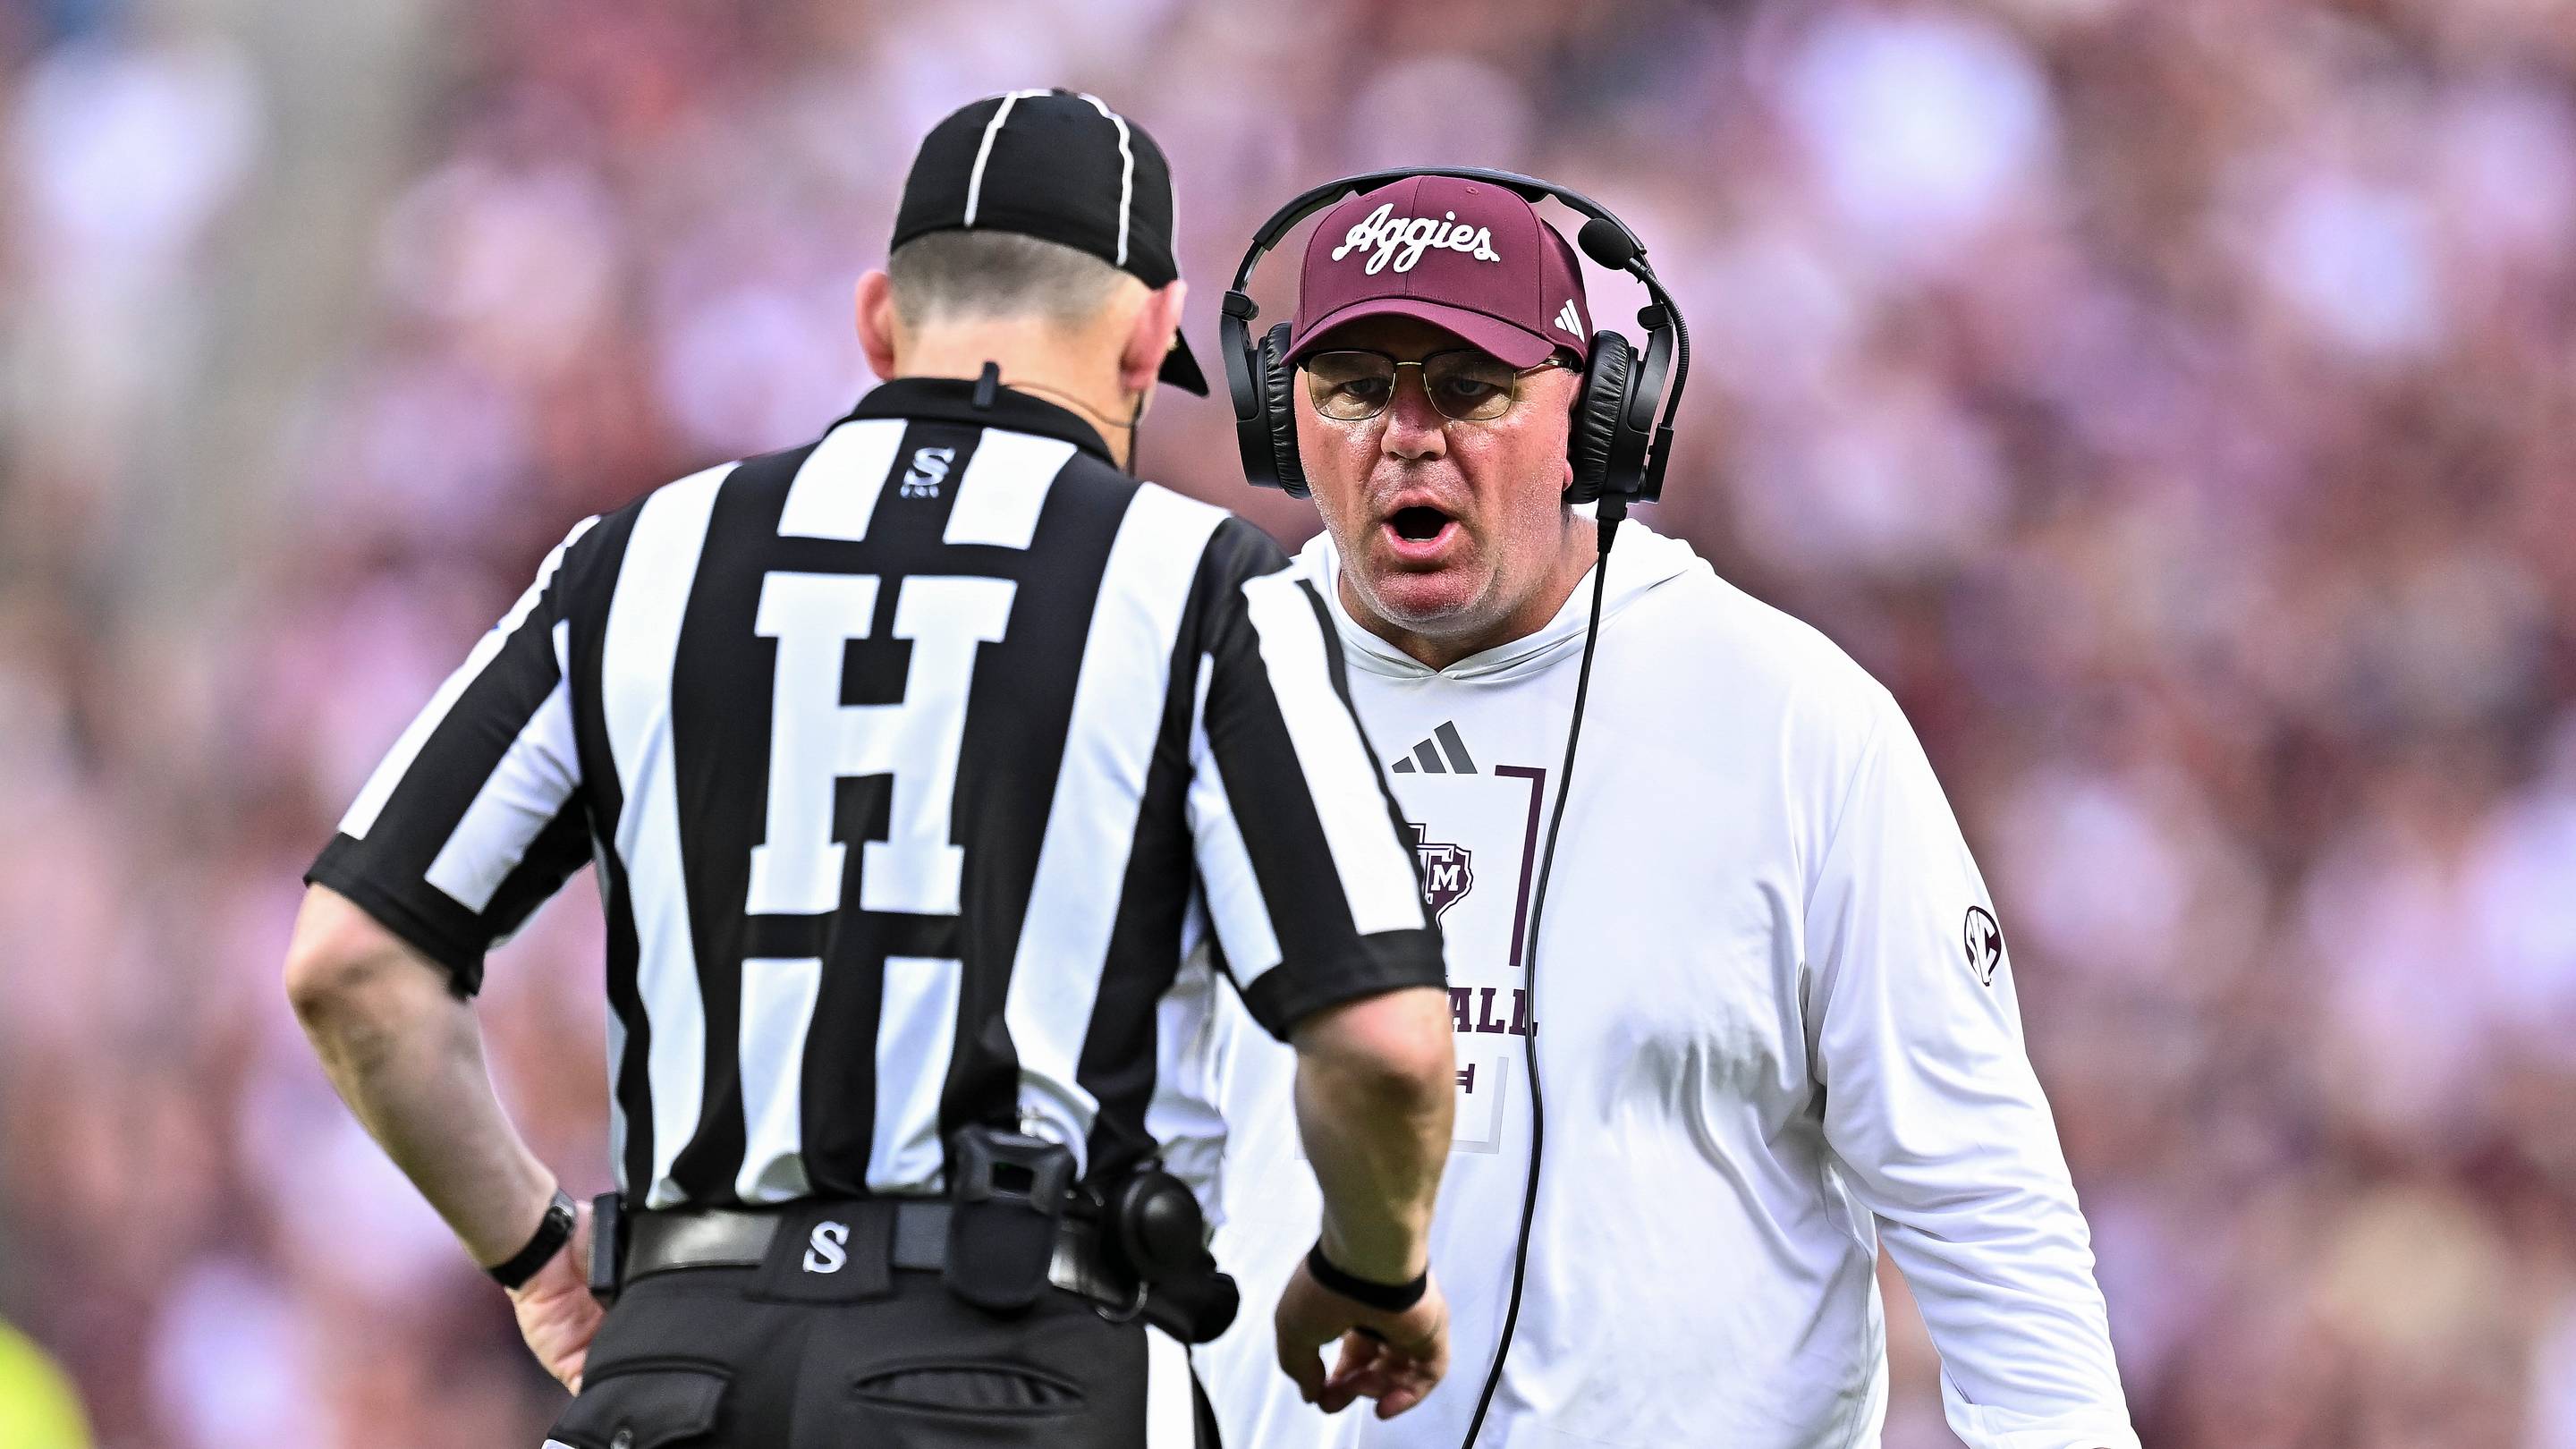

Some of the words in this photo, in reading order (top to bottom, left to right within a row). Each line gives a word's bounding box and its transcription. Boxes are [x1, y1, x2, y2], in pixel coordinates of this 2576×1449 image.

[1332, 203, 1501, 275] Aggies
[903, 446, 956, 486] S
[745, 571, 1018, 916] H
[803, 1220, 850, 1274] S
